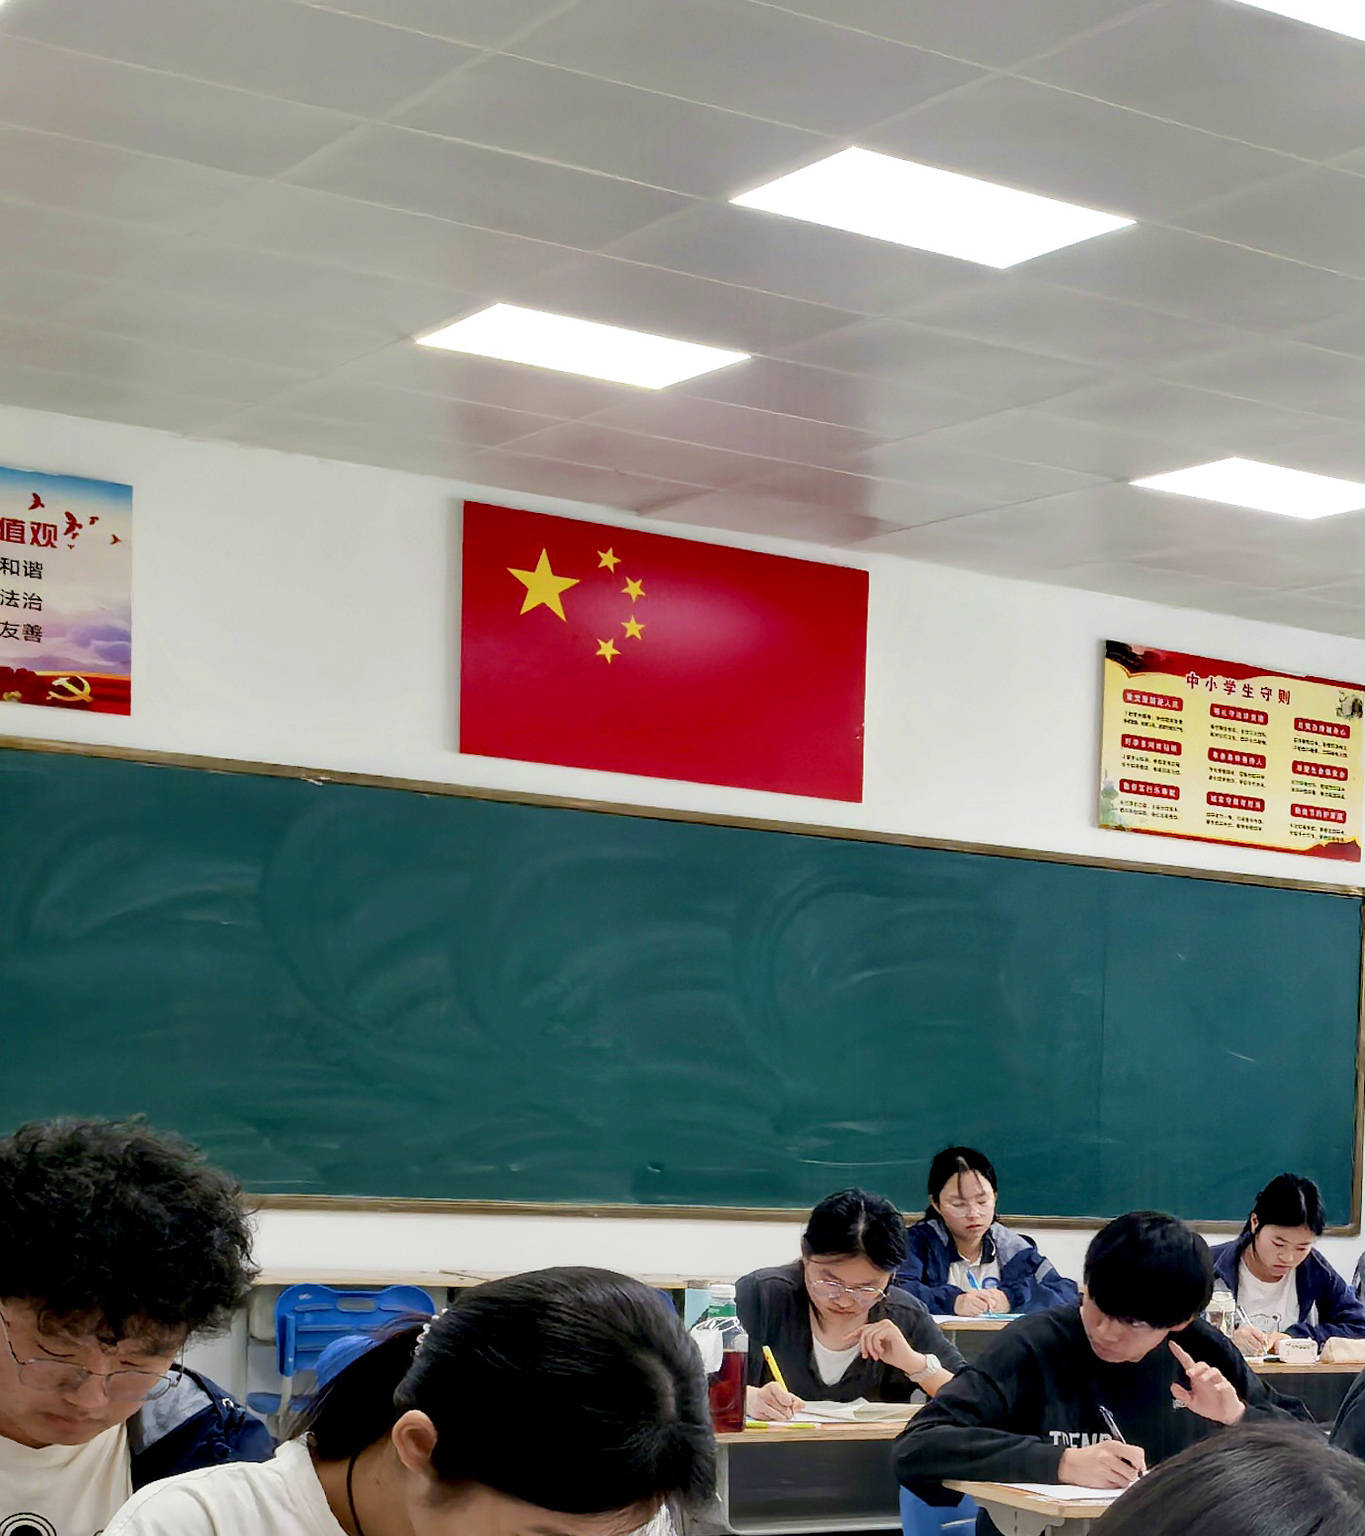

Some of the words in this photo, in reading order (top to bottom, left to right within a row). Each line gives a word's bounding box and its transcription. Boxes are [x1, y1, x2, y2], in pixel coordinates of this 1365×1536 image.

[0, 517, 58, 549] 值观
[0, 557, 43, 580] 和谐
[0, 589, 43, 612] 法治
[0, 621, 43, 644] 友善
[1186, 671, 1291, 705] 中小学生守则
